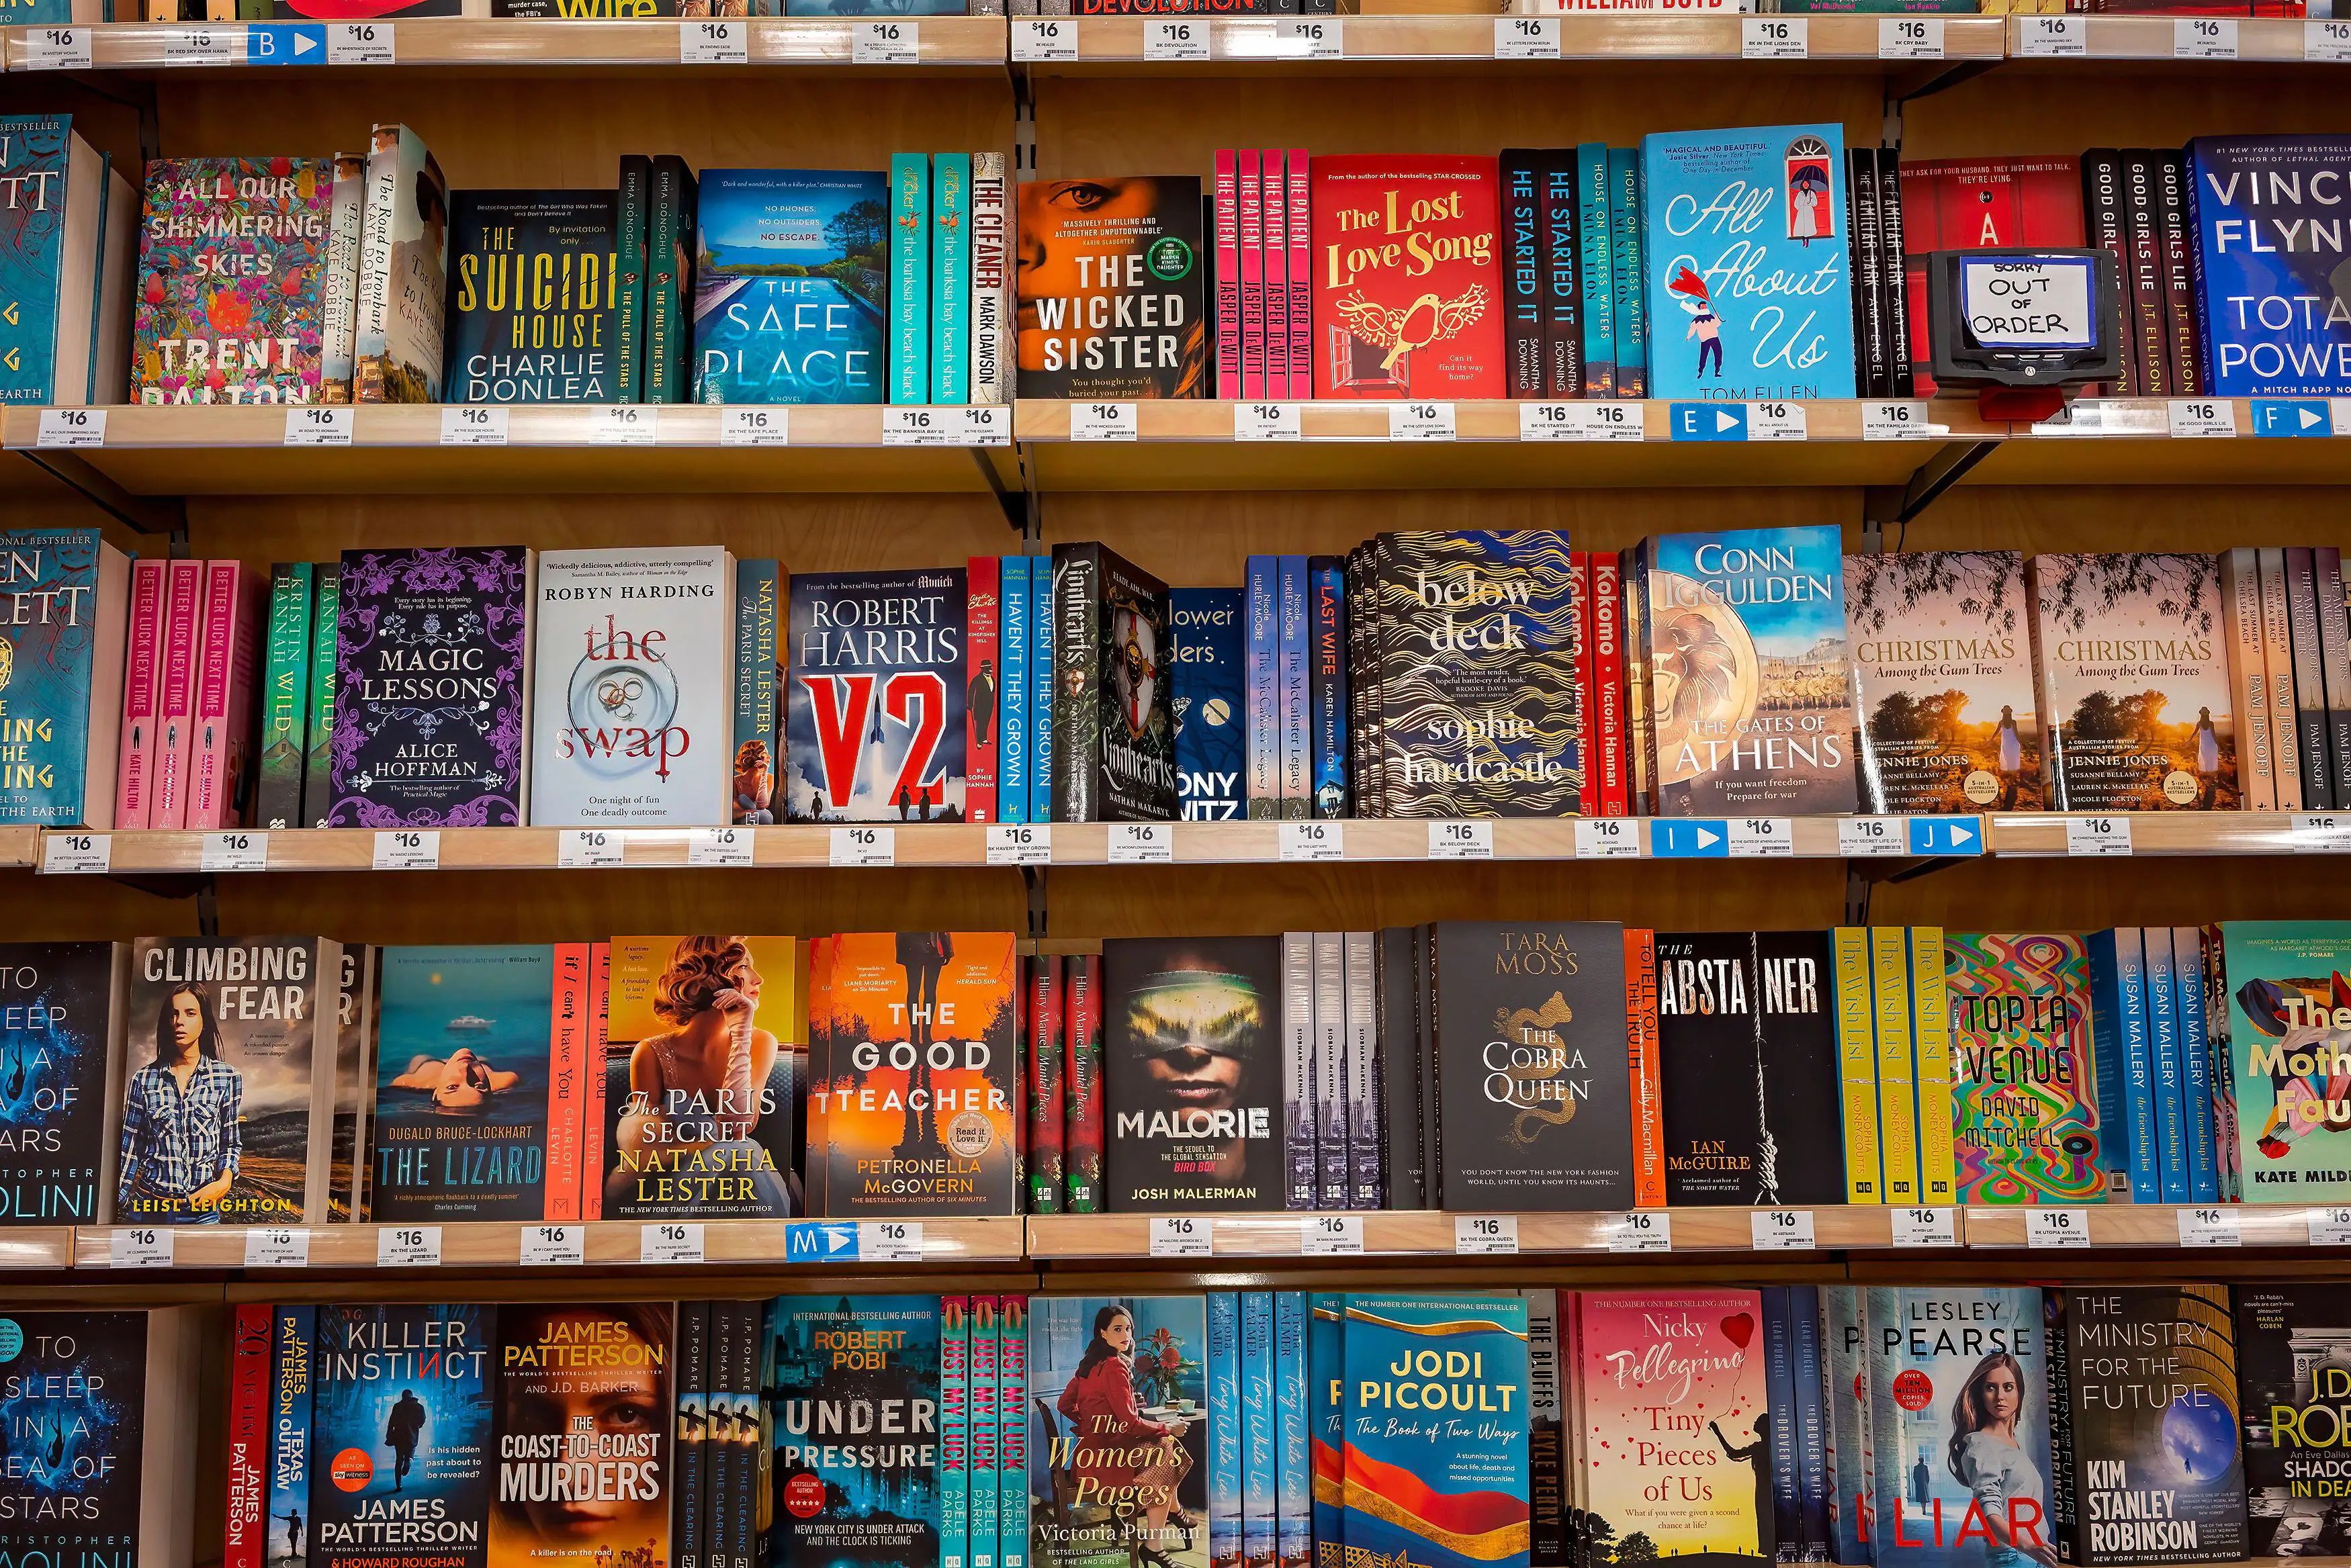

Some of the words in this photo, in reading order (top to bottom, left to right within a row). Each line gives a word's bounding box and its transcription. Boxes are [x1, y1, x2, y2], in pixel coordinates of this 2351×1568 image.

[46, 30, 72, 46] $16
[1163, 25, 1190, 40] $16
[1761, 24, 1787, 38] $16
[260, 33, 275, 56] B
[179, 178, 229, 199] ALL
[241, 176, 296, 199] OUR
[1337, 210, 1379, 232] The
[1384, 189, 1464, 235] Lost
[1665, 180, 1775, 238] All
[150, 216, 324, 240] SHIMMERING
[195, 255, 273, 276] SKIES
[1076, 256, 1145, 288] THE
[1325, 243, 1401, 289] Love
[1405, 231, 1493, 278] Song
[1665, 240, 1839, 299] About
[1994, 263, 2043, 273] SORRY
[765, 281, 812, 297] THE
[1989, 278, 2051, 295] OUT
[1036, 294, 1184, 330] WICKED
[2012, 298, 2032, 310] OF
[727, 303, 849, 340] SAFE
[1973, 314, 2068, 333] ORDER
[1750, 306, 1828, 369] Us
[158, 338, 299, 370] TRENT
[468, 354, 604, 375] CHARLIE
[1044, 335, 1179, 371] SISTER
[704, 350, 870, 387] PLACE
[468, 378, 603, 401] DONLEA
[740, 413, 767, 426] $16
[1685, 411, 1696, 432] E
[2187, 405, 2214, 418] $16
[2266, 408, 2278, 429] F
[1695, 545, 1794, 574] CONN
[545, 585, 617, 601] ROBYN
[621, 584, 715, 599] HARDING
[1418, 571, 1532, 608] below
[1665, 575, 1831, 608] IGGULDEN
[811, 597, 944, 629] ROBERT
[584, 614, 667, 662] the
[1429, 612, 1525, 651] deck
[801, 627, 958, 667] HARRIS
[2057, 640, 2212, 661] CHRISTMAS
[380, 649, 483, 671] MAGIC
[2075, 665, 2117, 681] Among
[2119, 665, 2136, 677] the
[2139, 665, 2168, 677] Gum
[2170, 665, 2200, 676] Trees
[361, 678, 497, 699] LESSONS
[1427, 710, 1535, 747] sophie
[394, 743, 457, 758] ALICE
[556, 725, 691, 783] swap
[375, 762, 478, 776] HOFFMAN
[1405, 750, 1562, 786] hardcastle
[1006, 829, 1032, 843] $16
[1446, 825, 1472, 839] $16
[1923, 825, 1933, 848] J
[144, 948, 306, 982] CLIMBING
[219, 986, 304, 1021] FEAR
[852, 1042, 991, 1071] GOOD
[1482, 1042, 1587, 1070] COBRA
[838, 1089, 1005, 1111] TEACHER
[1484, 1074, 1593, 1109] QUEEN
[389, 1125, 433, 1140] DUGALD
[436, 1125, 532, 1140] BRUCE-LOCKHART
[1117, 1108, 1270, 1139] MALORIE
[1691, 1141, 1724, 1154] IAN
[617, 1148, 777, 1173] NATASHA
[1669, 1156, 1751, 1170] McGUIRE
[636, 1177, 758, 1202] LESTER
[1131, 1189, 1168, 1200] JOSH
[1173, 1187, 1256, 1199] MALERMAN
[2044, 1213, 2069, 1228] $16
[396, 1231, 422, 1246] $16
[794, 1230, 817, 1253] M
[793, 1311, 849, 1321] INTERNATIONAL
[851, 1311, 900, 1320] BESTSELLING
[902, 1311, 931, 1320] AUTHOR
[1912, 1303, 2002, 1322] LESLEY
[348, 1321, 465, 1350] KILLER
[1643, 1313, 1707, 1344] Nicky
[1883, 1328, 2032, 1356] PEARSE
[1390, 1350, 1480, 1378] JODI
[1361, 1381, 1517, 1412] PICOULT
[785, 1399, 936, 1436] UNDER
[1644, 1407, 1704, 1438] Tiny
[500, 1433, 661, 1459] COAST-TO-COAST
[785, 1444, 936, 1469] PRESSURE
[1637, 1441, 1717, 1467] Pieces
[499, 1461, 661, 1502] MURDERS
[2087, 1461, 2126, 1489] KIM
[1644, 1476, 1673, 1501] of
[1679, 1477, 1712, 1502] Us
[2088, 1491, 2174, 1521] STANLEY
[1038, 1524, 1119, 1540] Victoria
[1125, 1523, 1200, 1541] Purman
[1893, 1497, 2044, 1548] LIAR
[2090, 1520, 2197, 1552] ROBINSON
